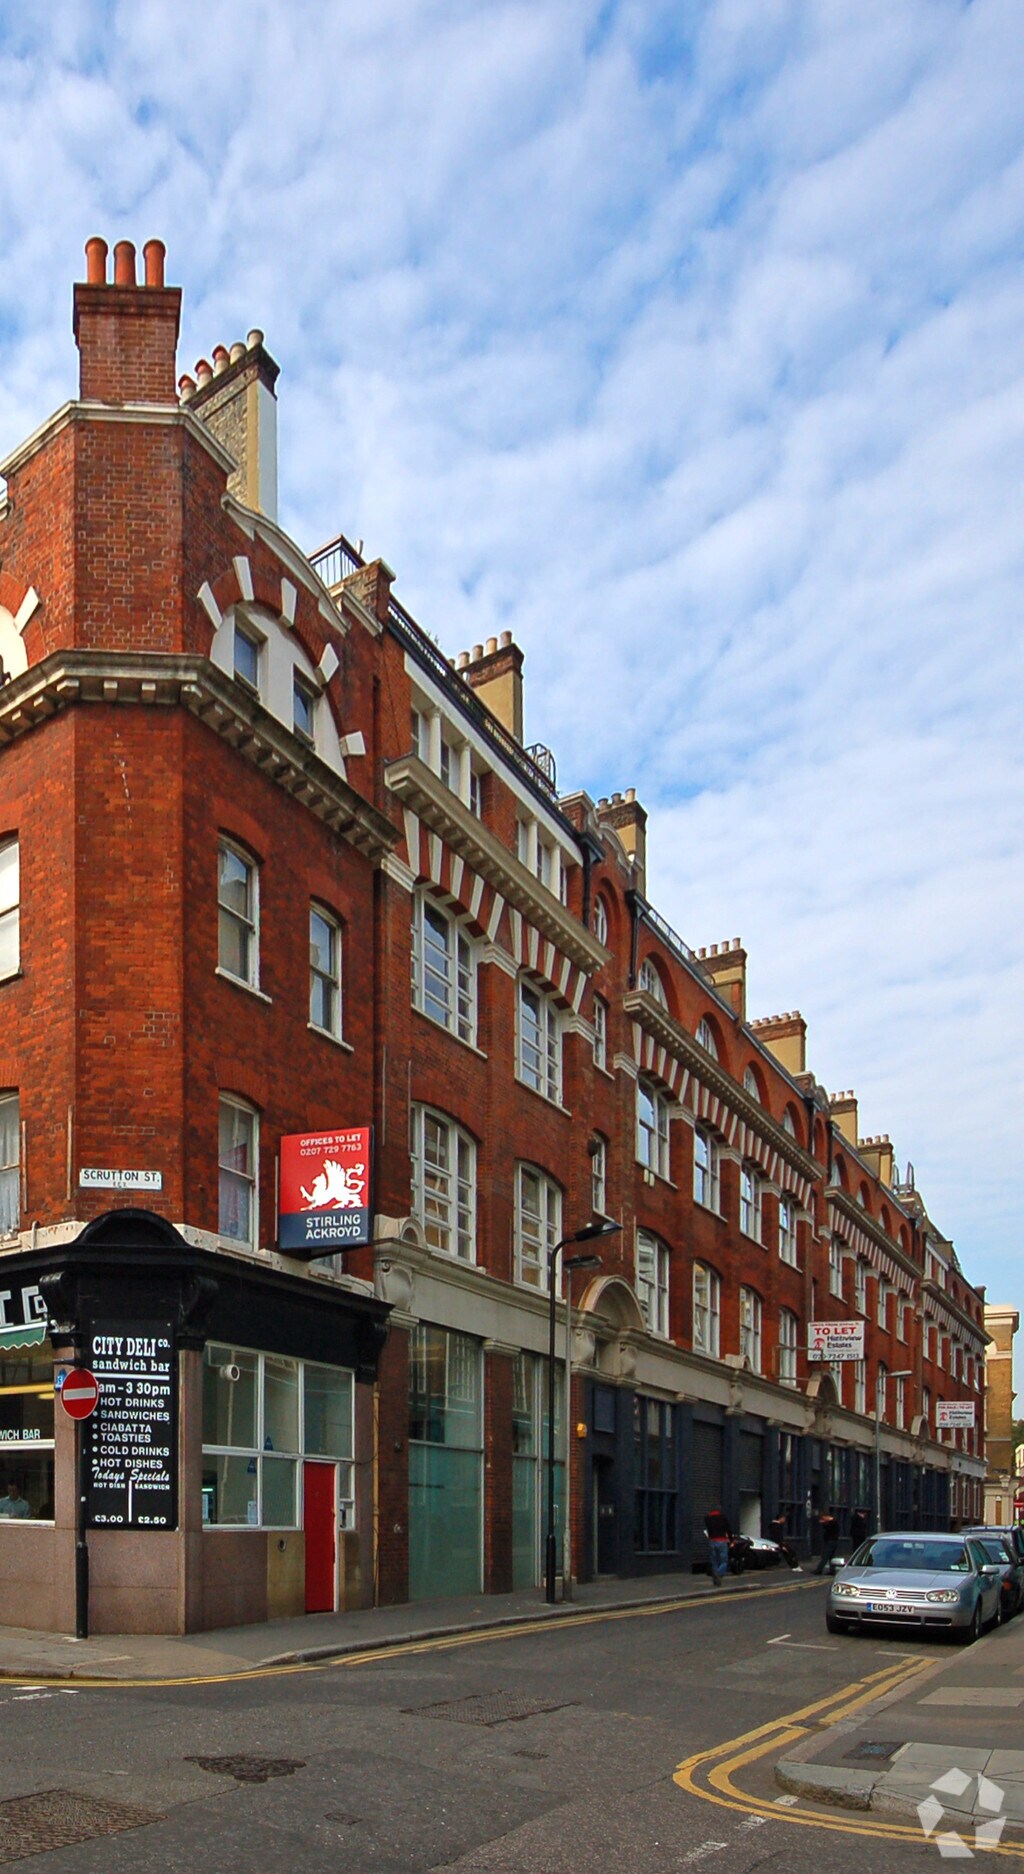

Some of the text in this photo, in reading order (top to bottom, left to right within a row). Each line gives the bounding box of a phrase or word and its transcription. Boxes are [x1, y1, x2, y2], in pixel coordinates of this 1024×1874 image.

[300, 1133, 361, 1147] OFFICES TO LET
[300, 1143, 362, 1156] 0207 729 7763
[83, 1170, 139, 1182] SCRUTTON
[306, 1214, 361, 1228] STIRLING
[305, 1226, 361, 1240] ACKROYD
[814, 1326, 857, 1335] TO LET
[92, 1336, 124, 1355] CITY
[126, 1337, 156, 1357] DELI
[92, 1358, 170, 1372] sandwich bar
[100, 1397, 165, 1408] HOT DRINKS
[100, 1410, 170, 1421] SANDWICHES
[100, 1422, 152, 1433] CIABATTA
[22, 1428, 41, 1440] BAR
[100, 1433, 151, 1443] TOASTIES
[100, 1445, 170, 1456] COLD DRINKS
[100, 1458, 163, 1468] HOT DISHES
[91, 1466, 170, 1484] Todays Specials
[94, 1514, 123, 1523] £3.00
